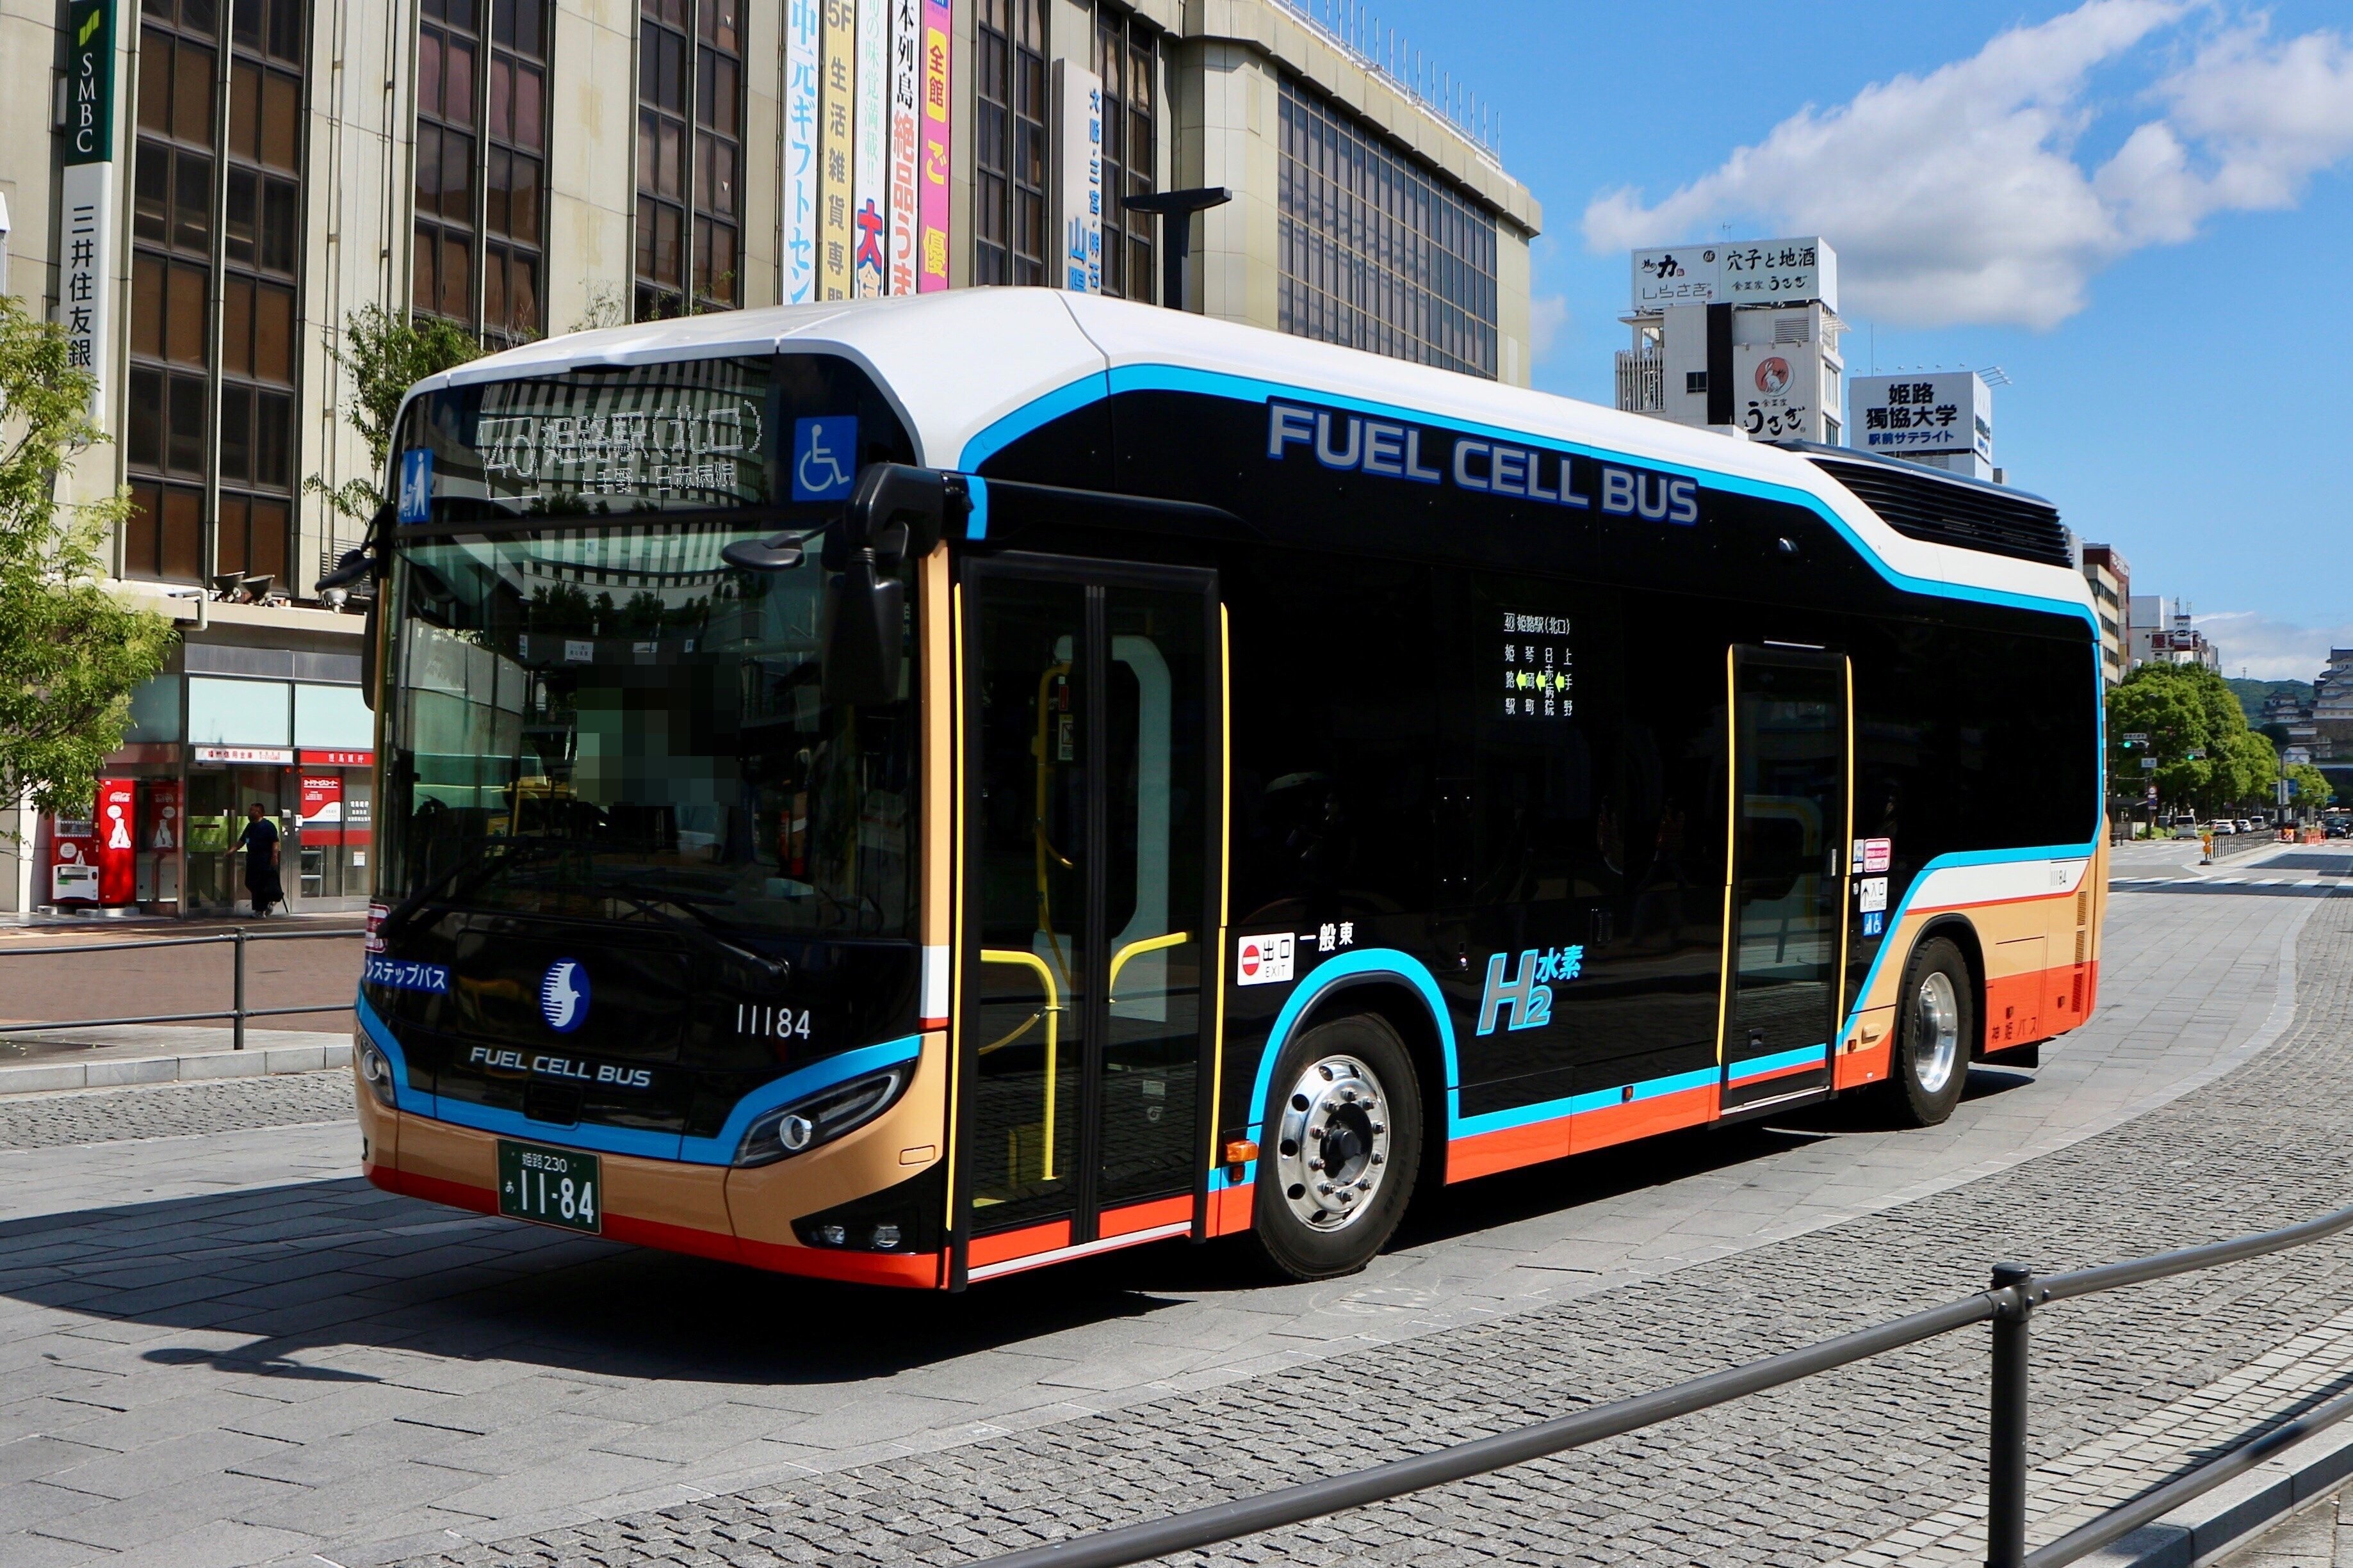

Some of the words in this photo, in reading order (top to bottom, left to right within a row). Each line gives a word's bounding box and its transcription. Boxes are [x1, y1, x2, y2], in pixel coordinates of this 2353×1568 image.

[827, 0, 852, 32] 5F
[929, 45, 944, 108] 全館
[76, 53, 96, 153] SMBC
[1727, 247, 1816, 271] 穴子と地酒
[1643, 282, 1711, 300] しらさぎ
[1769, 275, 1807, 291] うさぎ
[69, 205, 94, 408] 三井住友銀
[1889, 382, 1934, 405] 姫路
[1743, 401, 1805, 436] うさぎ
[1866, 405, 1957, 430] 獨協大学
[1868, 430, 1954, 446] 駅前サテライト
[1268, 403, 1441, 484] FUEL
[1453, 437, 1590, 509] CELL
[1601, 466, 1698, 525] BUS
[1264, 939, 1290, 961] 出口
[1299, 921, 1353, 952] 一般東
[1266, 964, 1285, 978] EXIT
[1536, 944, 1583, 982] 水素
[737, 1003, 811, 1040] 11184
[469, 1047, 527, 1072] FUEL
[532, 1056, 592, 1081] CELL
[597, 1064, 651, 1088] BUS
[521, 1170, 594, 1224] 11-84
